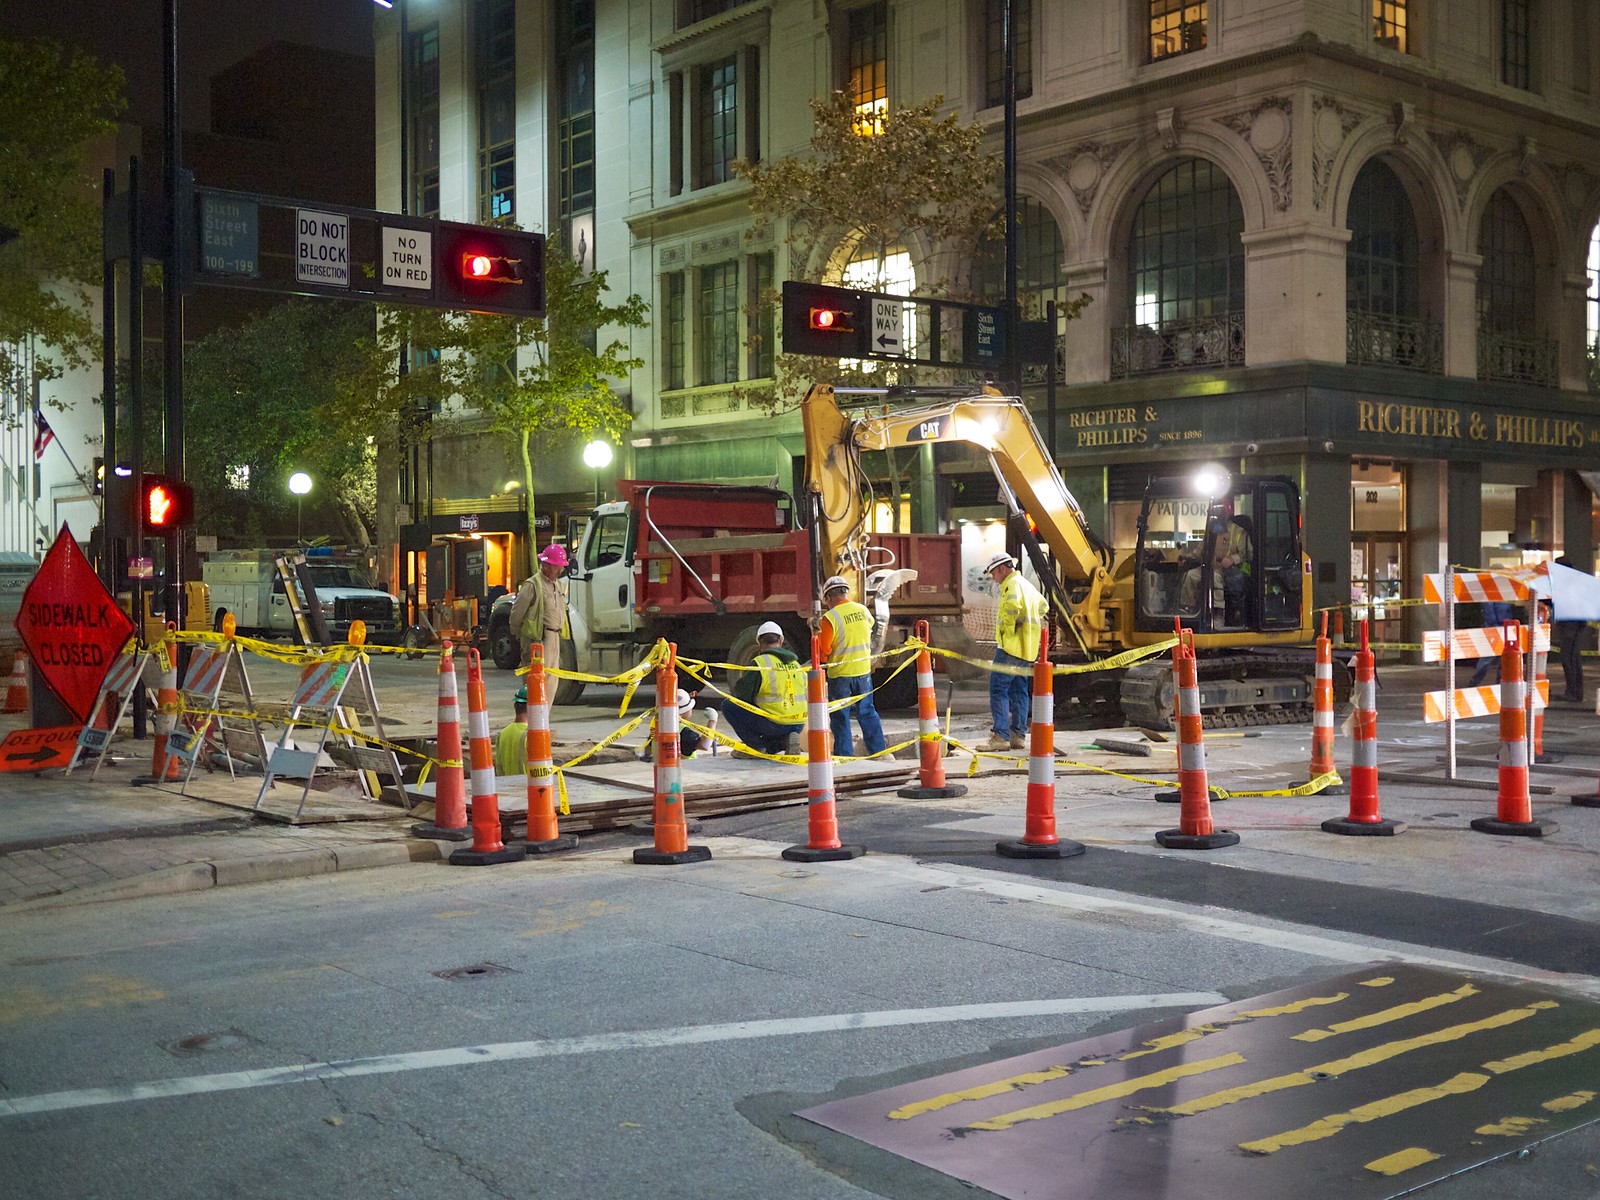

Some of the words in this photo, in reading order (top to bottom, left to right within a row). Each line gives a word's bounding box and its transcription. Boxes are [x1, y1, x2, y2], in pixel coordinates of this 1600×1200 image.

[206, 200, 240, 216] Sixth
[205, 214, 248, 234] Street
[300, 219, 317, 236] DO
[321, 222, 346, 240] NOT
[205, 230, 235, 247] East
[398, 237, 417, 250] NO
[300, 243, 346, 263] BLOCK
[392, 252, 422, 266] TURN
[205, 255, 254, 273] 100-199
[300, 263, 347, 280] INTERSECTION
[386, 267, 401, 278] ON
[406, 270, 428, 282] RED
[876, 303, 898, 317] ONE
[977, 311, 994, 324] Sixth
[876, 317, 899, 331] WAY
[977, 323, 996, 335] Street
[977, 334, 991, 345] East
[1069, 408, 1137, 427] RICHTER
[1144, 406, 1158, 422] &
[1357, 400, 1463, 439] RICHTER
[1469, 411, 1488, 441] &
[1495, 413, 1585, 448] PHILLIPS
[920, 422, 940, 439] CAT
[1077, 427, 1148, 447] PHILLIPS
[1160, 431, 1181, 440] SINCE
[1184, 431, 1203, 440] 1896
[1366, 490, 1378, 503] 202
[1157, 502, 1207, 516] PADOR
[461, 518, 478, 530] Izzy's
[29, 603, 111, 627] SIDEWALK
[41, 642, 103, 667] CLOSED
[8, 730, 79, 746] DETOUR
[1290, 784, 1314, 796] CAUTION
